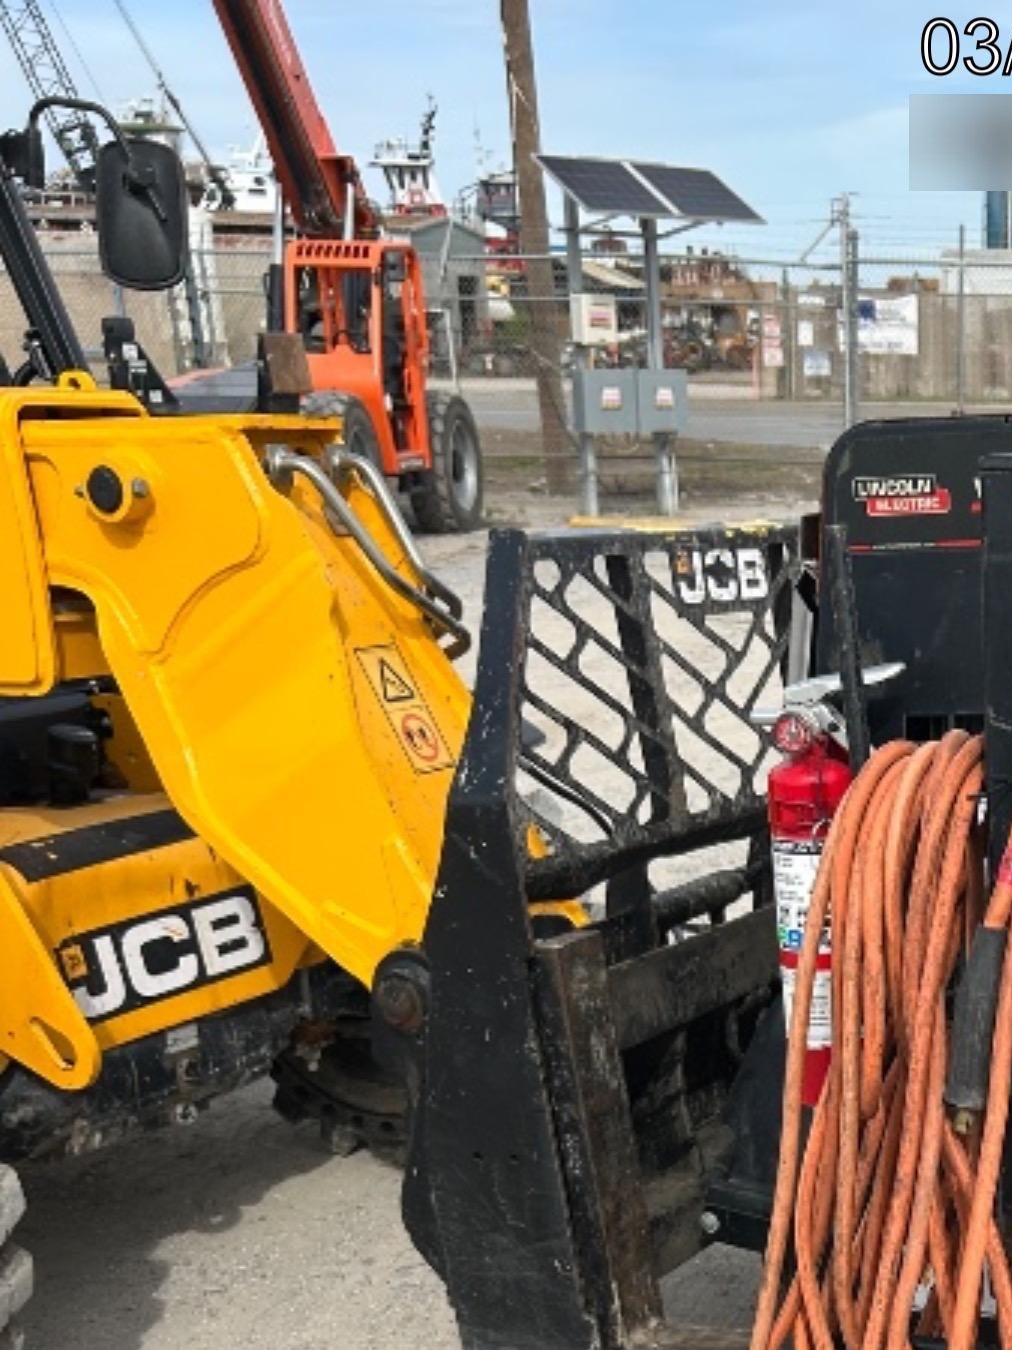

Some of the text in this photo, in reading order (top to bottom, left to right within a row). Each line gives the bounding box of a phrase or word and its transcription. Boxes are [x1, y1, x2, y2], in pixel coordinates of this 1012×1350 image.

[856, 478, 933, 497] LINCOLN
[679, 549, 769, 604] JCB
[73, 895, 265, 1019] JCB
